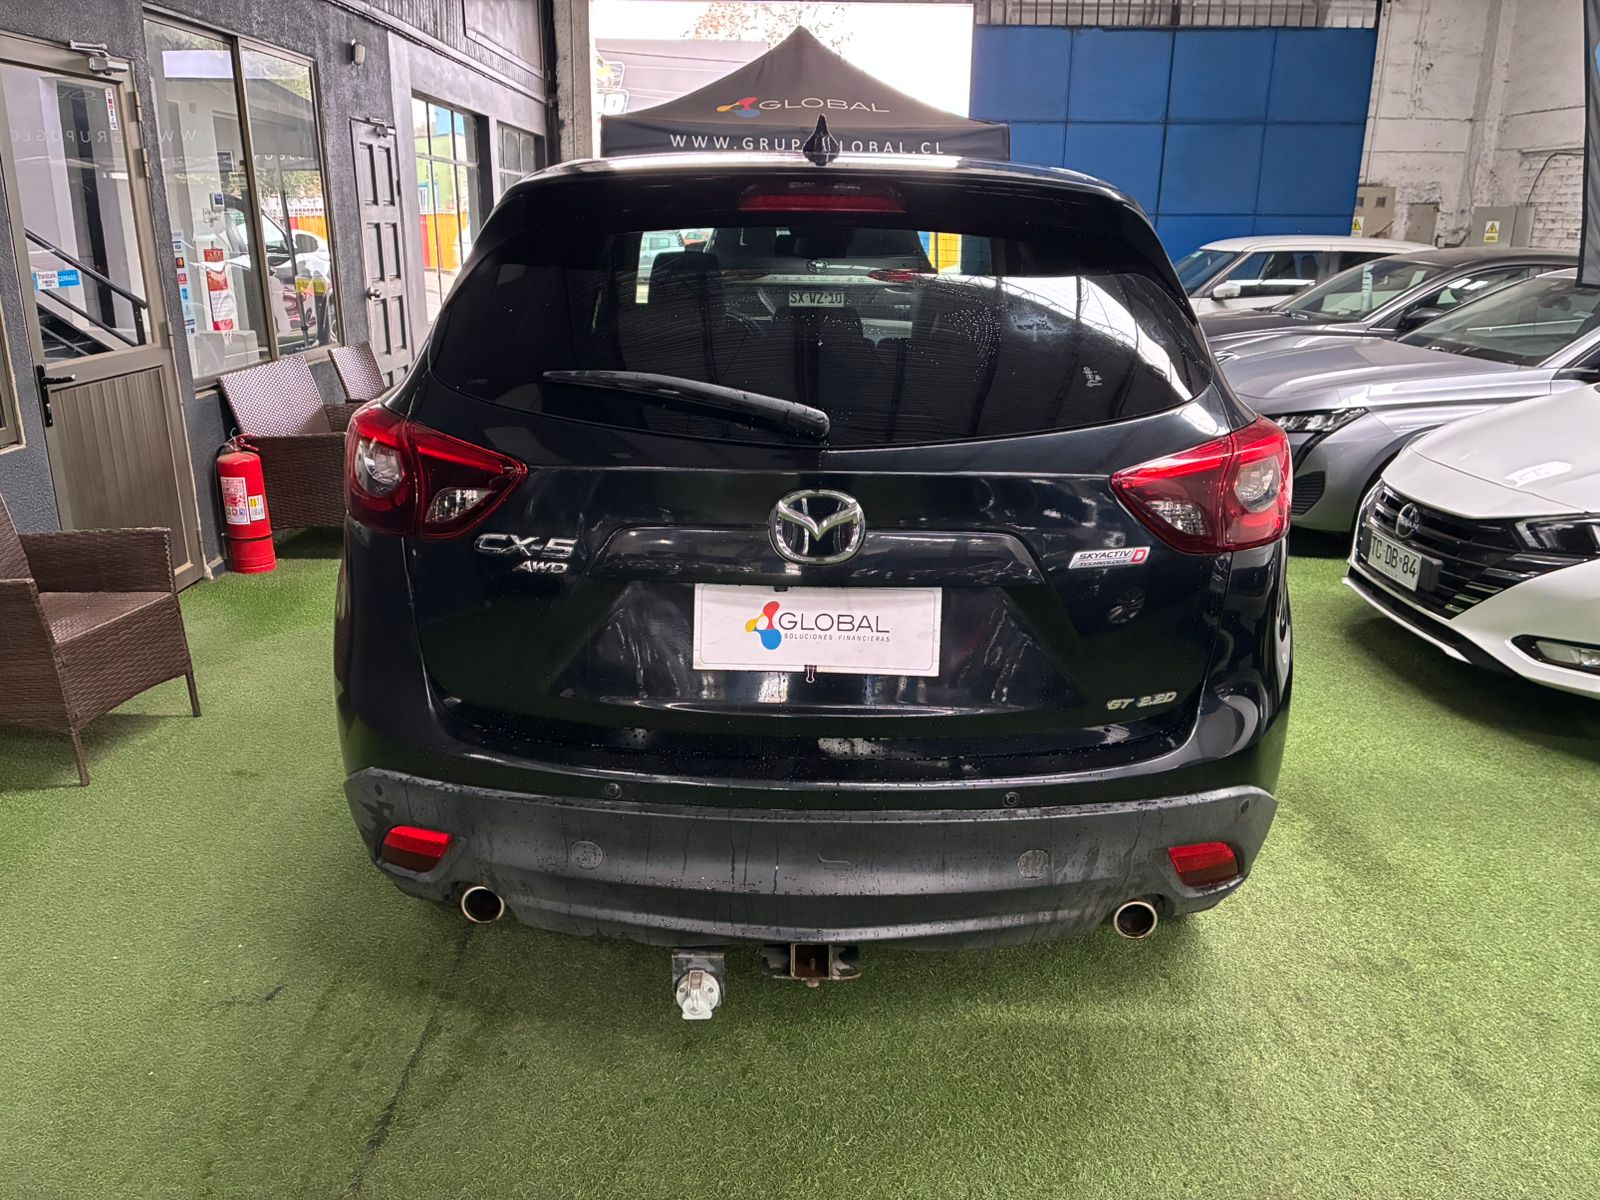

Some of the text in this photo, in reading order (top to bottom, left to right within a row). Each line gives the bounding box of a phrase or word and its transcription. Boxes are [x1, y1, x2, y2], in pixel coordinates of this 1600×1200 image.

[758, 97, 890, 113] GLOBAL
[670, 134, 944, 154] WWW.GRUPLOBAL.CL
[473, 533, 578, 559] CX-5
[1078, 550, 1131, 560] SKYACTIV
[511, 560, 569, 574] AWD
[778, 612, 890, 633] GLOBAL
[784, 633, 890, 643] SOLUCIONES FINANCIERAS
[1106, 698, 1135, 710] GT
